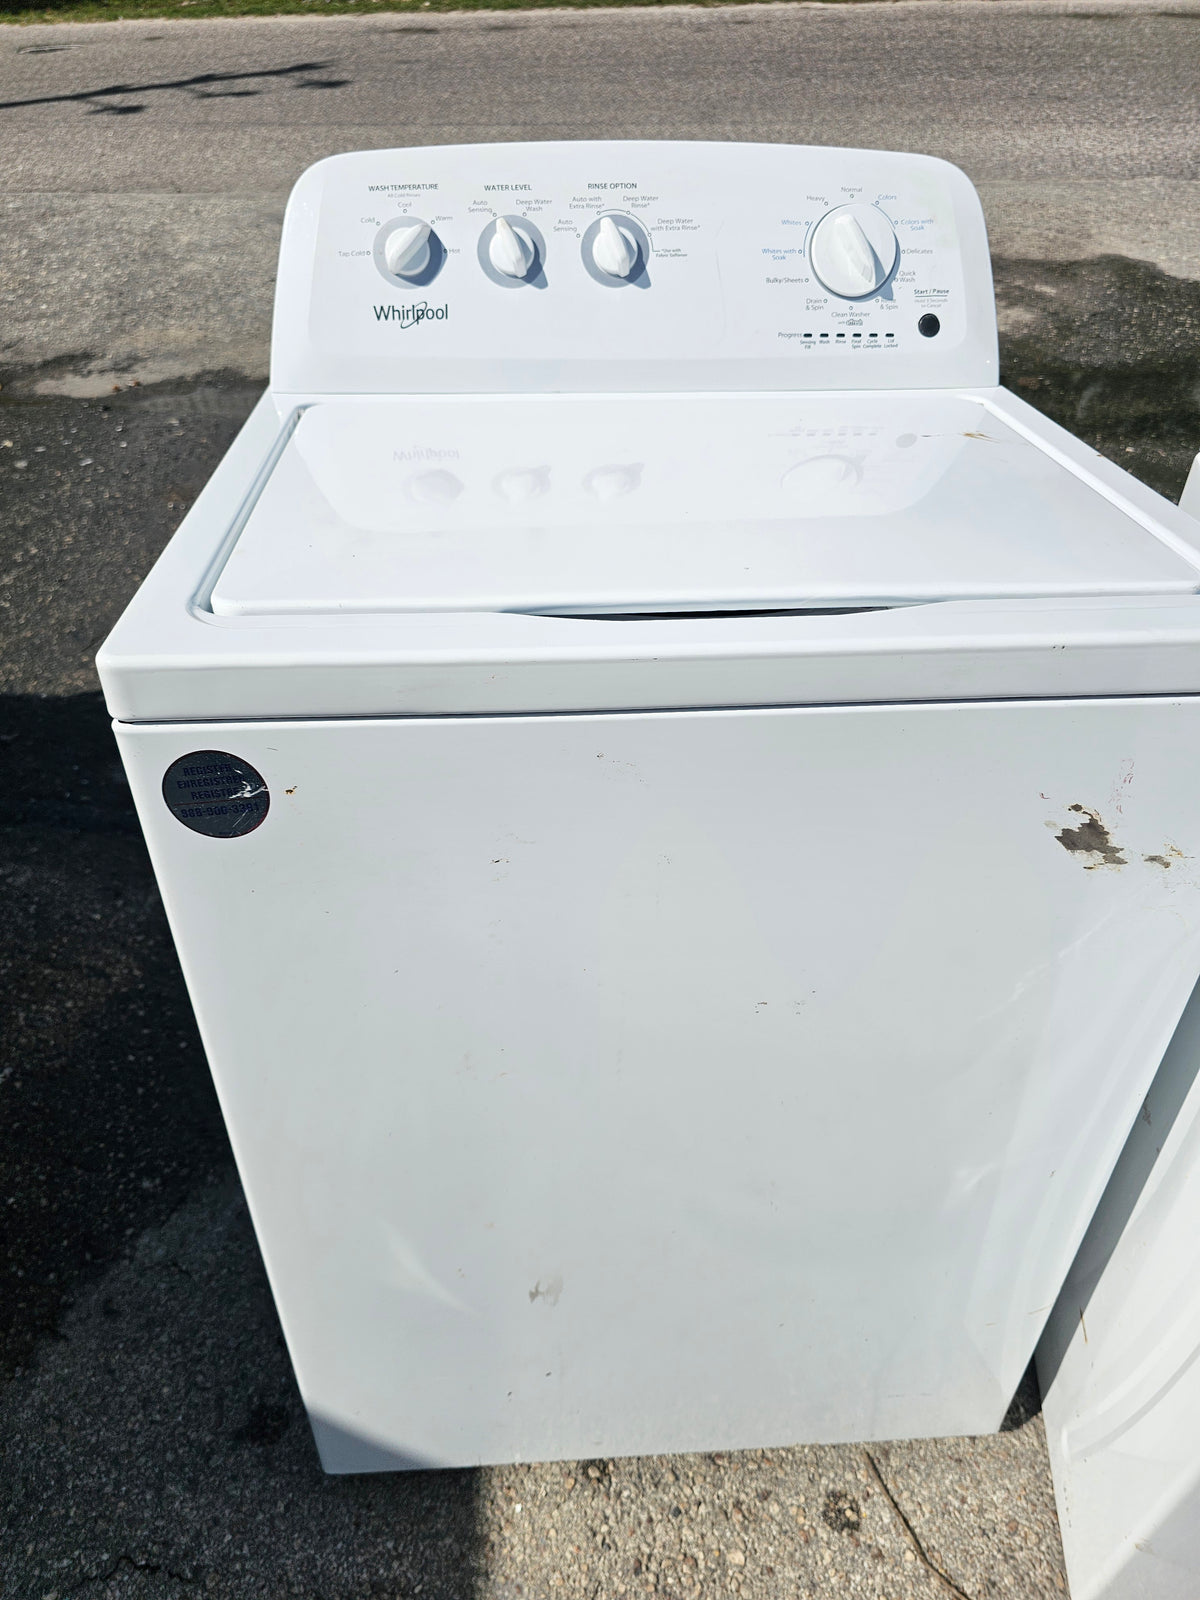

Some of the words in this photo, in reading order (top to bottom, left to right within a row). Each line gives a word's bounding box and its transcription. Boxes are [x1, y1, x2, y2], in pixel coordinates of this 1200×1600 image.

[368, 185, 389, 193] WASH
[389, 183, 439, 192] TEMPERATURE
[468, 206, 493, 214] Sensing
[553, 225, 578, 233] Sensing
[338, 250, 350, 258] Tap
[373, 303, 449, 326] Whirlpool
[183, 763, 232, 776] REGISTER
